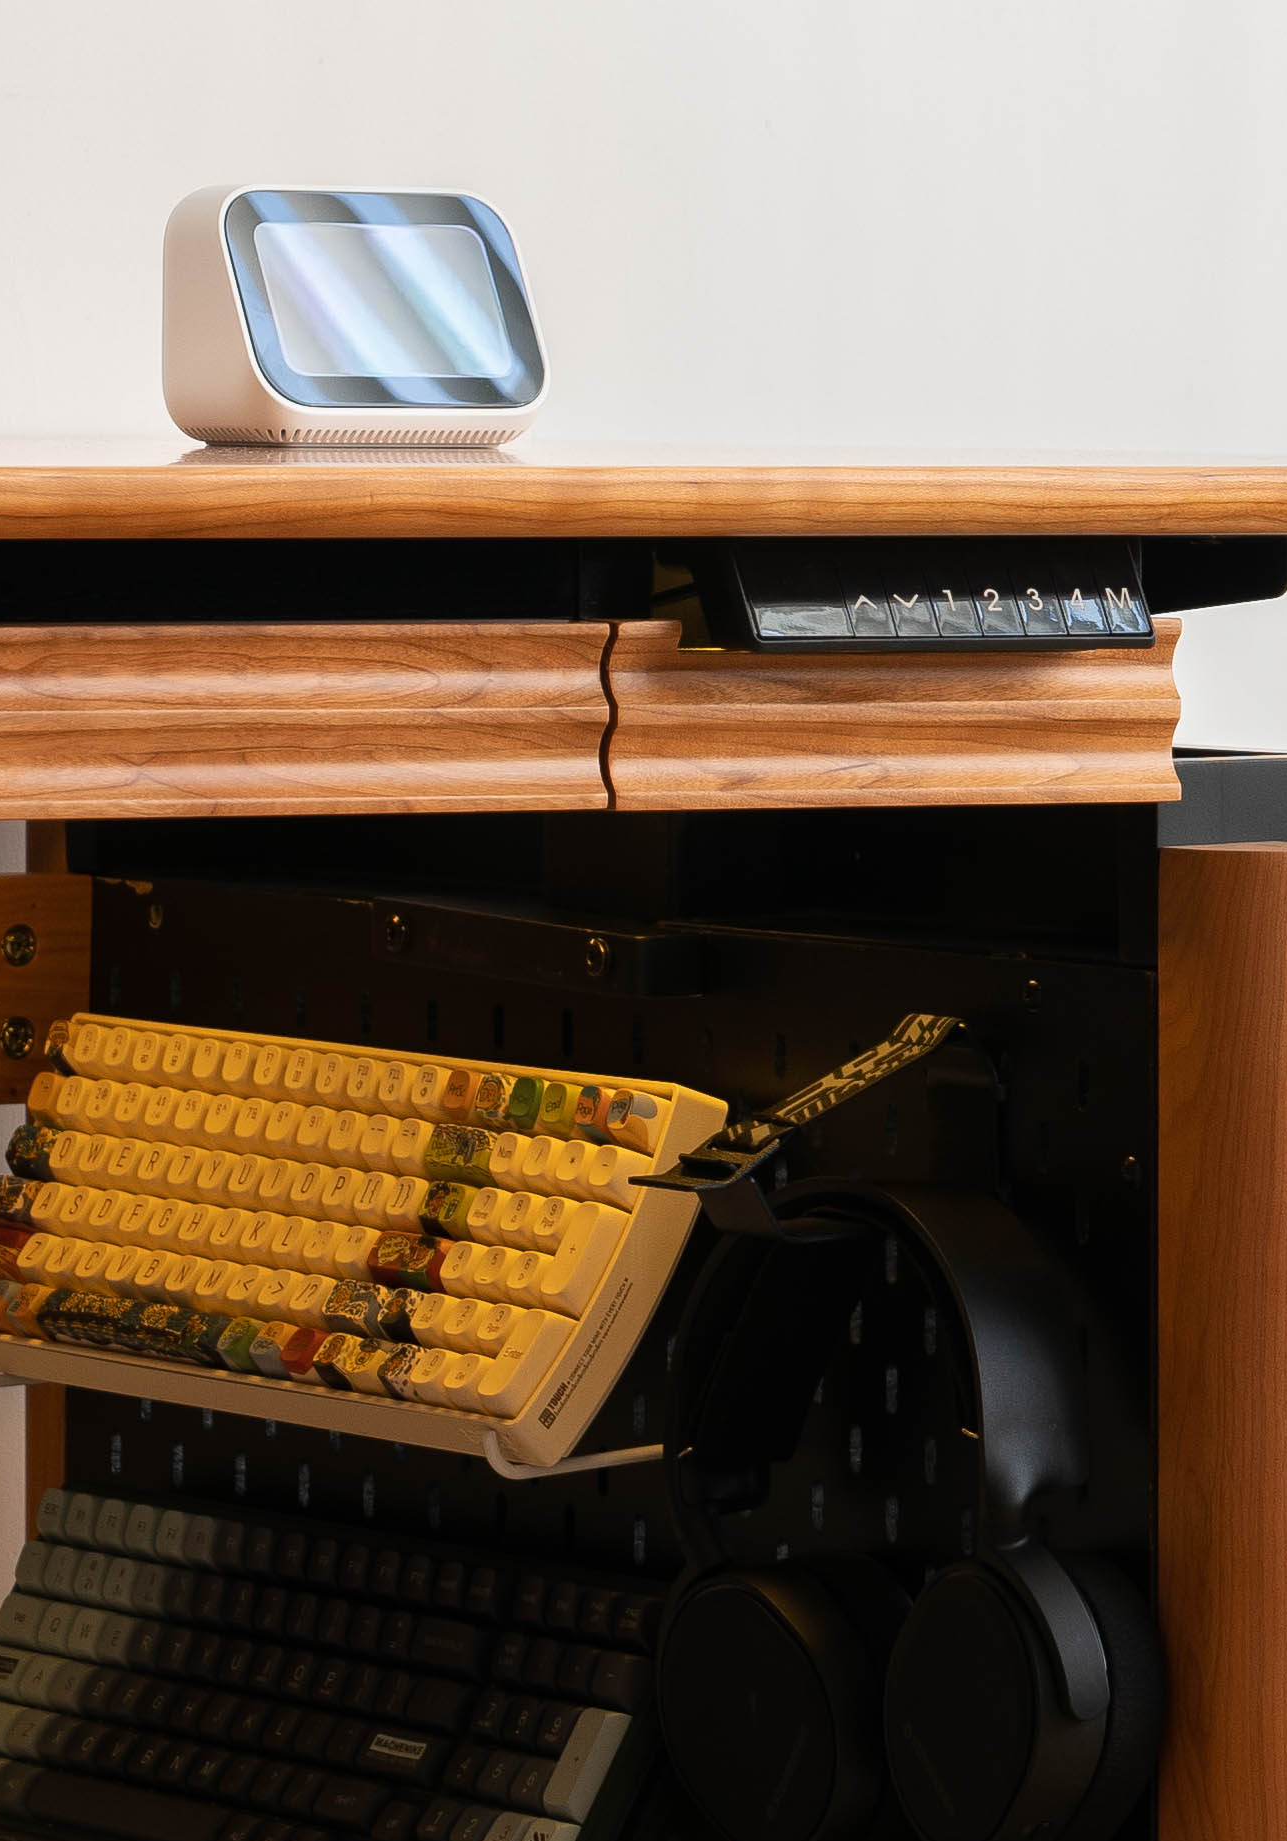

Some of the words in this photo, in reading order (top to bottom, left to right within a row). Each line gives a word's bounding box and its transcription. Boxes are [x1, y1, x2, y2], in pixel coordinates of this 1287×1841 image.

[942, 589, 956, 611] 1
[983, 588, 1003, 611] 2
[1026, 588, 1043, 611] 3
[1070, 588, 1085, 609] 4
[1104, 587, 1133, 609] M
[59, 1137, 72, 1160] Q
[88, 1138, 102, 1162] W
[116, 1147, 131, 1168] E
[146, 1151, 160, 1171] R
[177, 1155, 191, 1177] T
[209, 1160, 221, 1181] Y
[239, 1163, 252, 1185] U
[300, 1172, 314, 1194] O
[331, 1175, 346, 1197] P
[39, 1192, 53, 1210] A
[69, 1194, 83, 1215] S
[98, 1198, 113, 1218] D
[128, 1204, 143, 1223] F
[158, 1207, 173, 1228] G
[186, 1212, 202, 1232] H
[219, 1217, 234, 1237] J
[249, 1220, 265, 1241] K
[281, 1225, 293, 1246] L
[26, 1241, 42, 1260] Z
[56, 1246, 70, 1265] X
[85, 1251, 99, 1271] C
[120, 1254, 133, 1273] V
[144, 1258, 160, 1278] B
[175, 1264, 191, 1284] N
[203, 1270, 221, 1289] M
